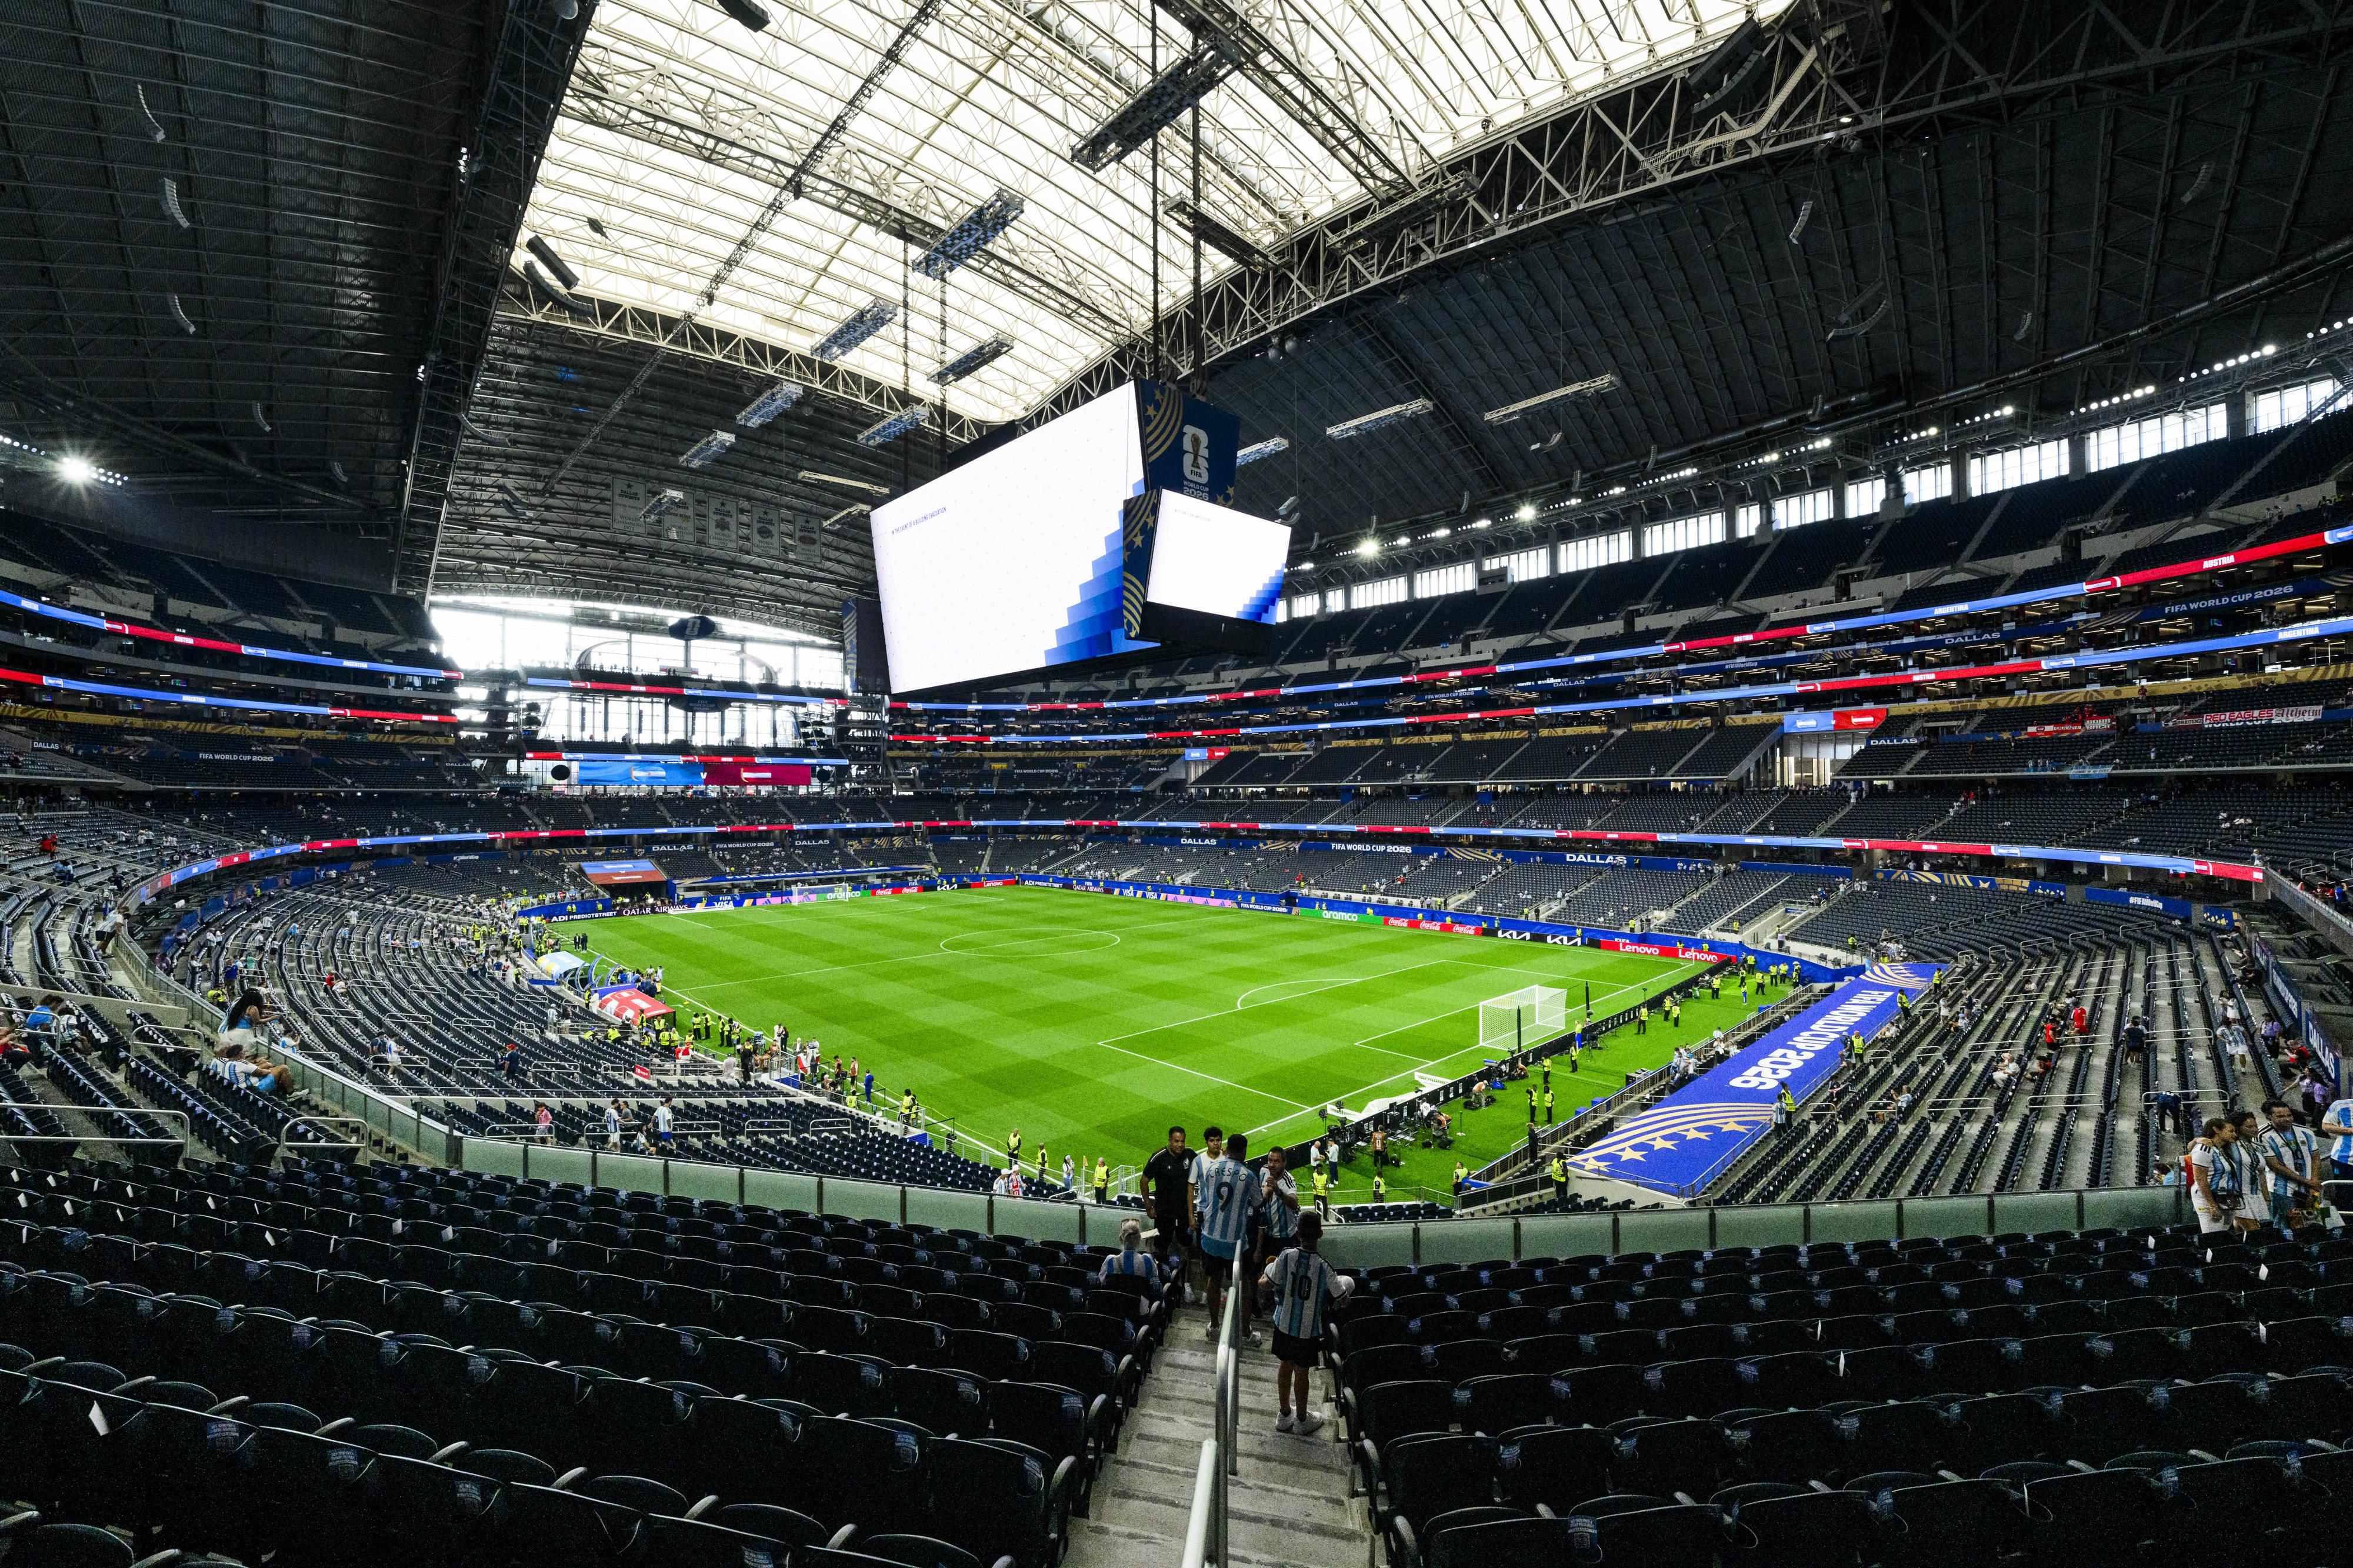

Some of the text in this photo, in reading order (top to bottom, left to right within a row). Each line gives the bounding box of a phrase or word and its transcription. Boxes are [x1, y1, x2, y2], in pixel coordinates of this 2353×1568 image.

[1191, 470, 1202, 478] FIFA
[1184, 480, 1199, 489] WORLD
[1184, 487, 1209, 501] 2026
[2202, 555, 2234, 569] AUSTRIA
[2165, 586, 2294, 614] FIFA WORLD CUP 2026
[1934, 604, 1968, 615] ARGENTINA
[1733, 634, 1753, 642] AUSTRIA
[1945, 632, 2001, 645] DALLAS
[2278, 627, 2319, 640] ARGENTINA
[2205, 707, 2321, 722] RED EAGLES Altheim
[34, 741, 59, 749] DALLAS
[1346, 843, 1371, 852] WORLD
[1566, 854, 1627, 865] DALLAS
[827, 890, 861, 899] aramco
[623, 904, 689, 916] QATAR AIRWAYS
[1322, 910, 1358, 922] aramco
[1388, 918, 1408, 927] Coca-Cola
[1420, 921, 1441, 930] Coca-Cola
[1453, 925, 1476, 935] Coca-Cola
[1619, 942, 1659, 955] Lenovo
[1679, 949, 1718, 962] Lenovo
[1729, 990, 1894, 1089] FIFA WORLD CUP 2026
[2308, 1020, 2335, 1080] DALLAS
[1209, 1168, 1247, 1181] CRESPO
[1217, 1181, 1234, 1213] 9
[1291, 1272, 1312, 1301] 10
